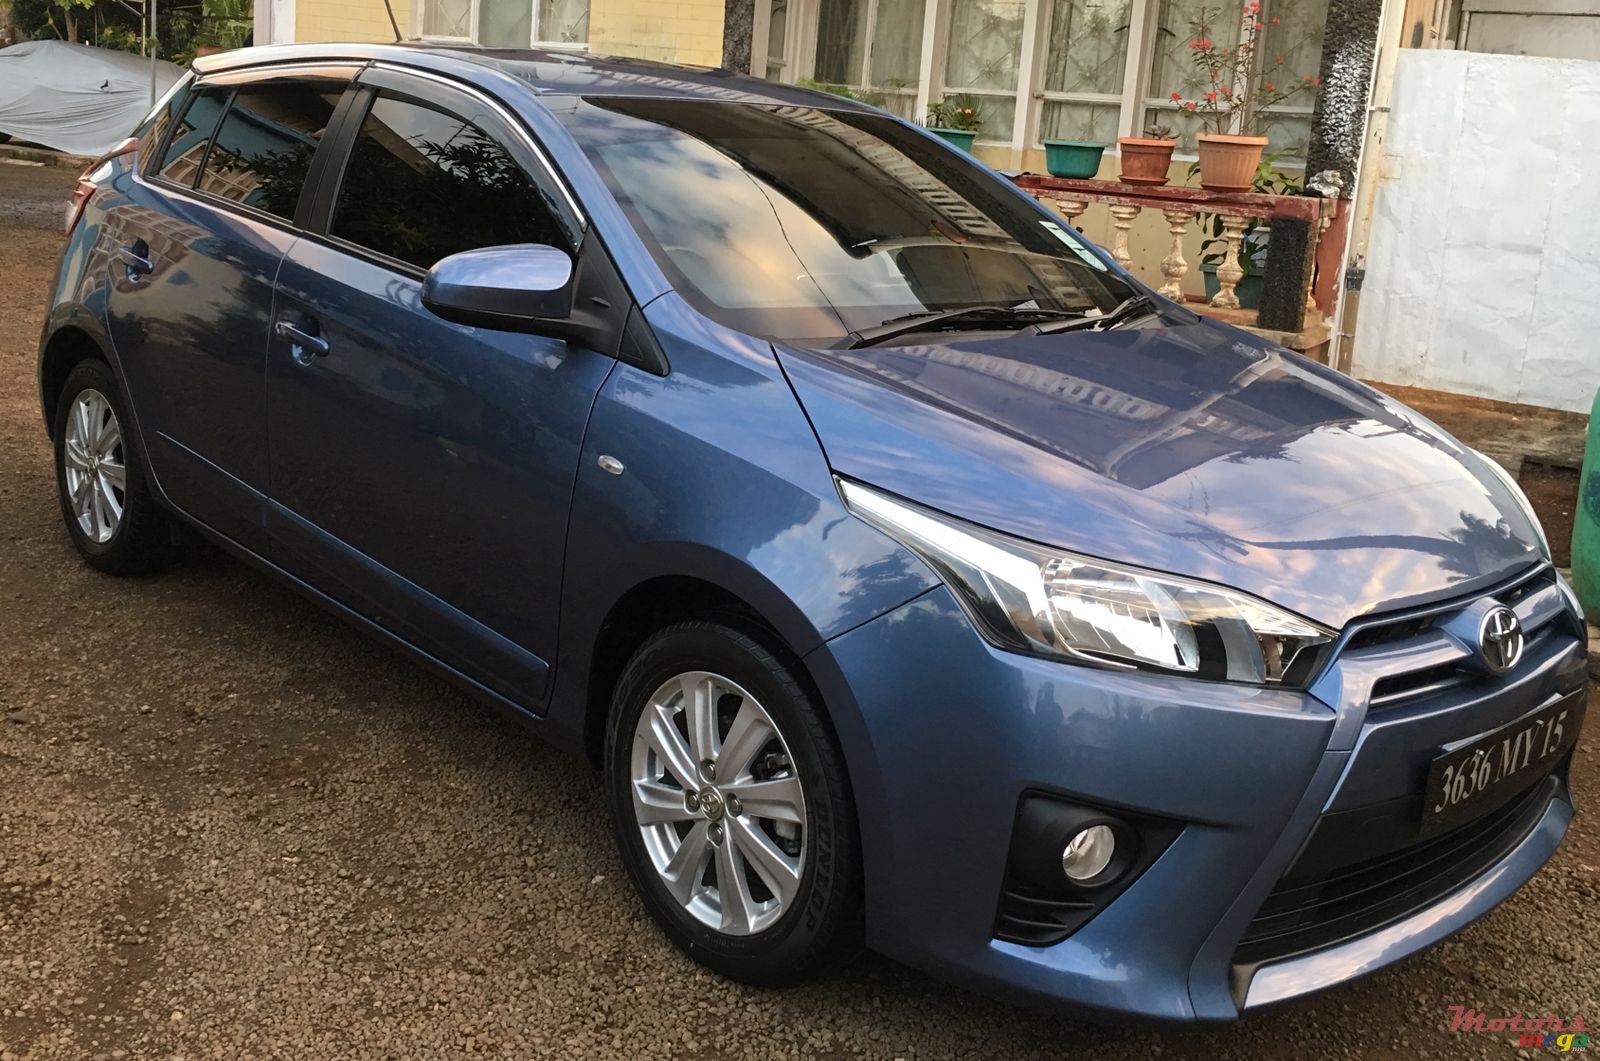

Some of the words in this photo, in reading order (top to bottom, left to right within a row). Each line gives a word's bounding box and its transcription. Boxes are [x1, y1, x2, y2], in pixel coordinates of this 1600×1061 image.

[1434, 745, 1496, 813] 3636
[1494, 724, 1541, 783] MY
[1539, 710, 1568, 759] 15
[806, 801, 832, 932] DUNLOP
